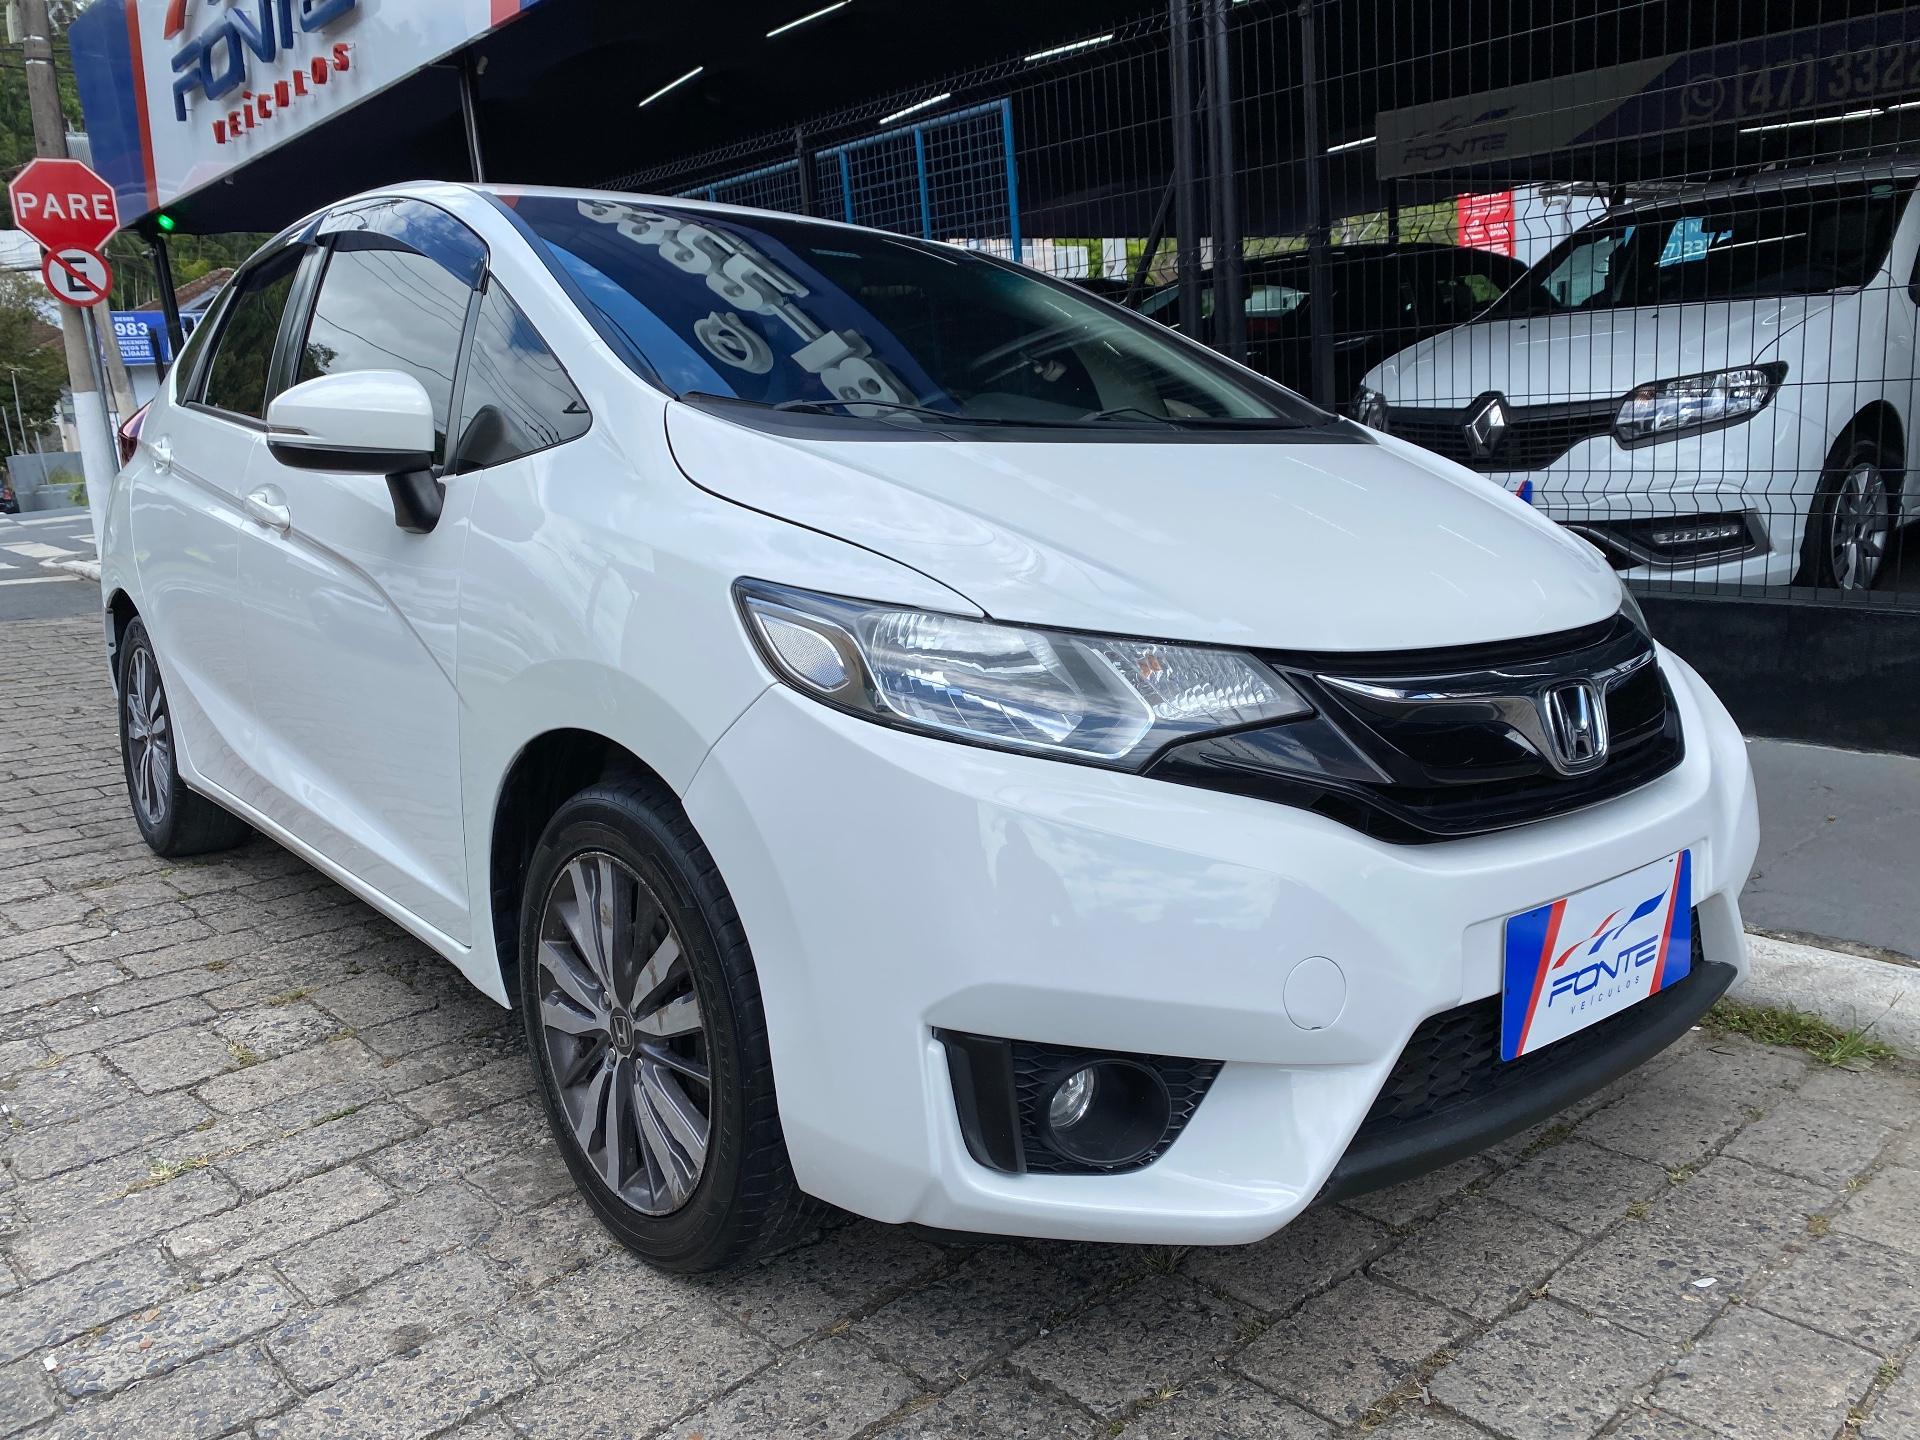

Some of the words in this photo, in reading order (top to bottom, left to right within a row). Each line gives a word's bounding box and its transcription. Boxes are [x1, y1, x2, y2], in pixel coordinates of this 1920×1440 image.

[212, 42, 350, 144] VEÍCULOS
[16, 192, 114, 220] PARE
[62, 257, 93, 292] E
[1548, 934, 1659, 1008] FONTE
